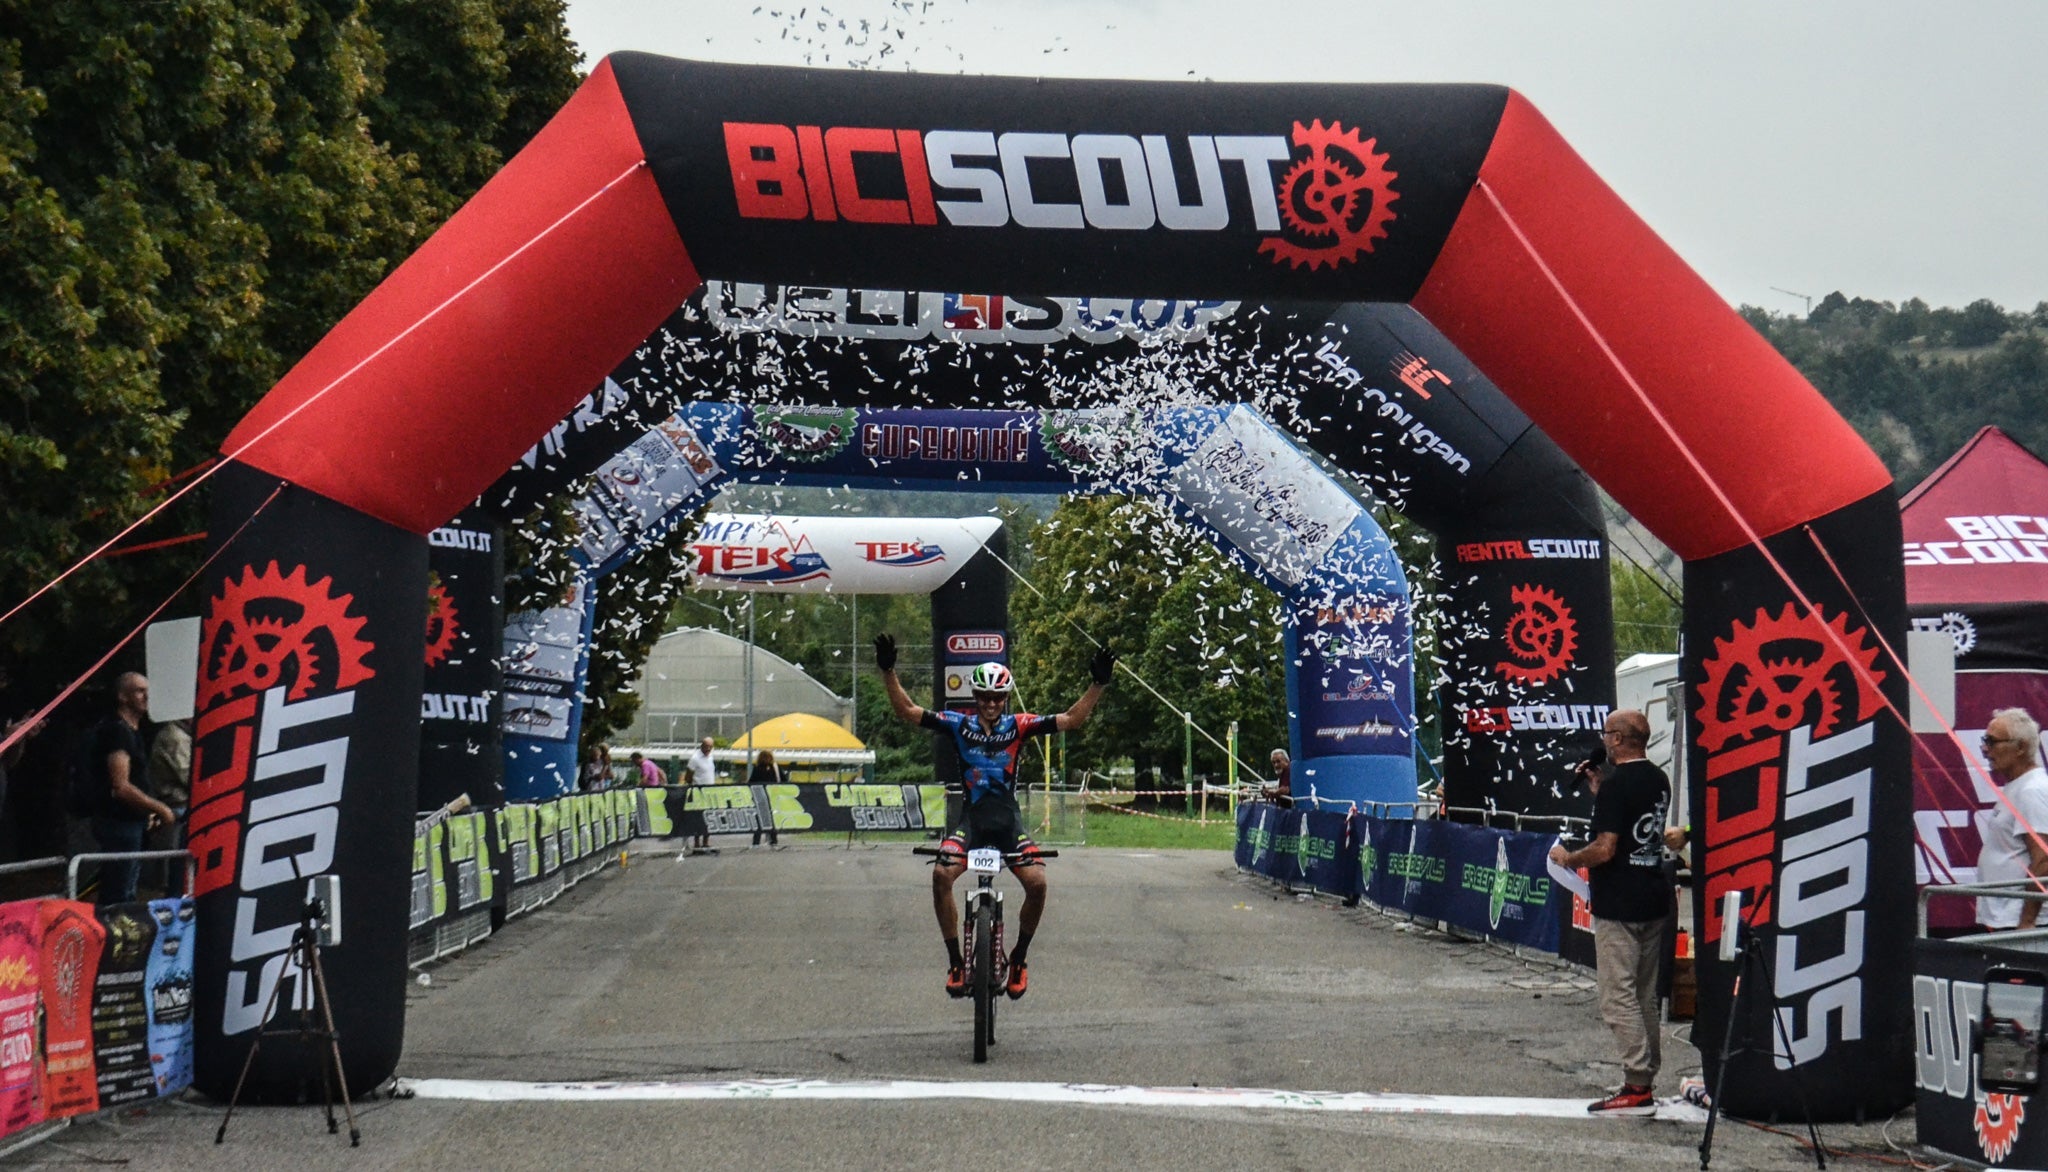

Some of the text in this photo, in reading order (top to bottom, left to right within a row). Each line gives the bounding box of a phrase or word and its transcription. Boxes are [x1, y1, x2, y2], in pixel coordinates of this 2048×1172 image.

[722, 121, 1290, 231] BICISCOUT
[862, 422, 1029, 463] SUPERBIKE
[1945, 515, 2048, 540] BICI
[683, 544, 797, 576] TEK
[855, 541, 924, 562] TEK
[1903, 540, 2048, 566] SCOU
[954, 637, 999, 650] ABUS
[187, 694, 257, 897] BICI
[703, 808, 759, 833] SCOUT
[851, 806, 907, 829] SCOUT
[1704, 735, 1783, 944] BICI
[222, 686, 356, 1036] SCOUT
[974, 857, 995, 868] 002
[1773, 721, 1874, 1071] SCOUT
